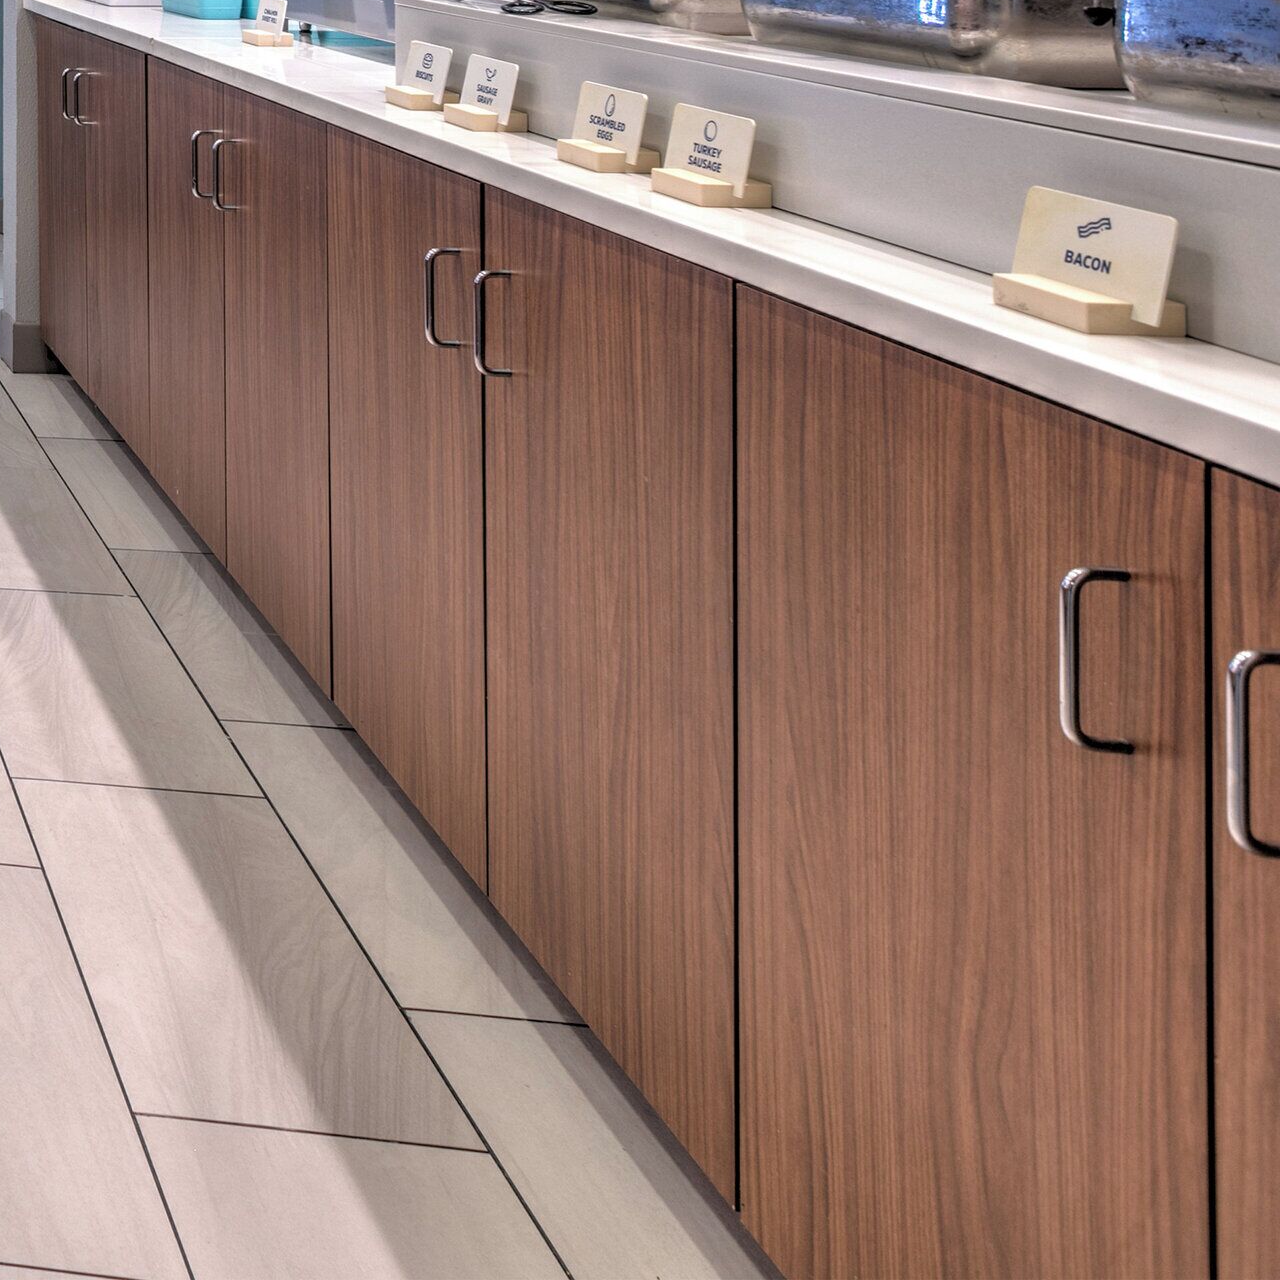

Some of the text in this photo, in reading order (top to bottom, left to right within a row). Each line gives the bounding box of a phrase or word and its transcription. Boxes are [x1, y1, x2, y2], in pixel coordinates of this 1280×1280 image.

[415, 70, 434, 82] BISCUITS
[476, 83, 498, 97] SAUSAGE
[476, 94, 494, 106] GRAVY
[589, 114, 626, 132] SCRAMBLED
[596, 129, 613, 141] EGGS
[693, 142, 722, 159] TURKEY
[687, 155, 722, 173] SAUSAGE
[1063, 249, 1112, 275] BACON
